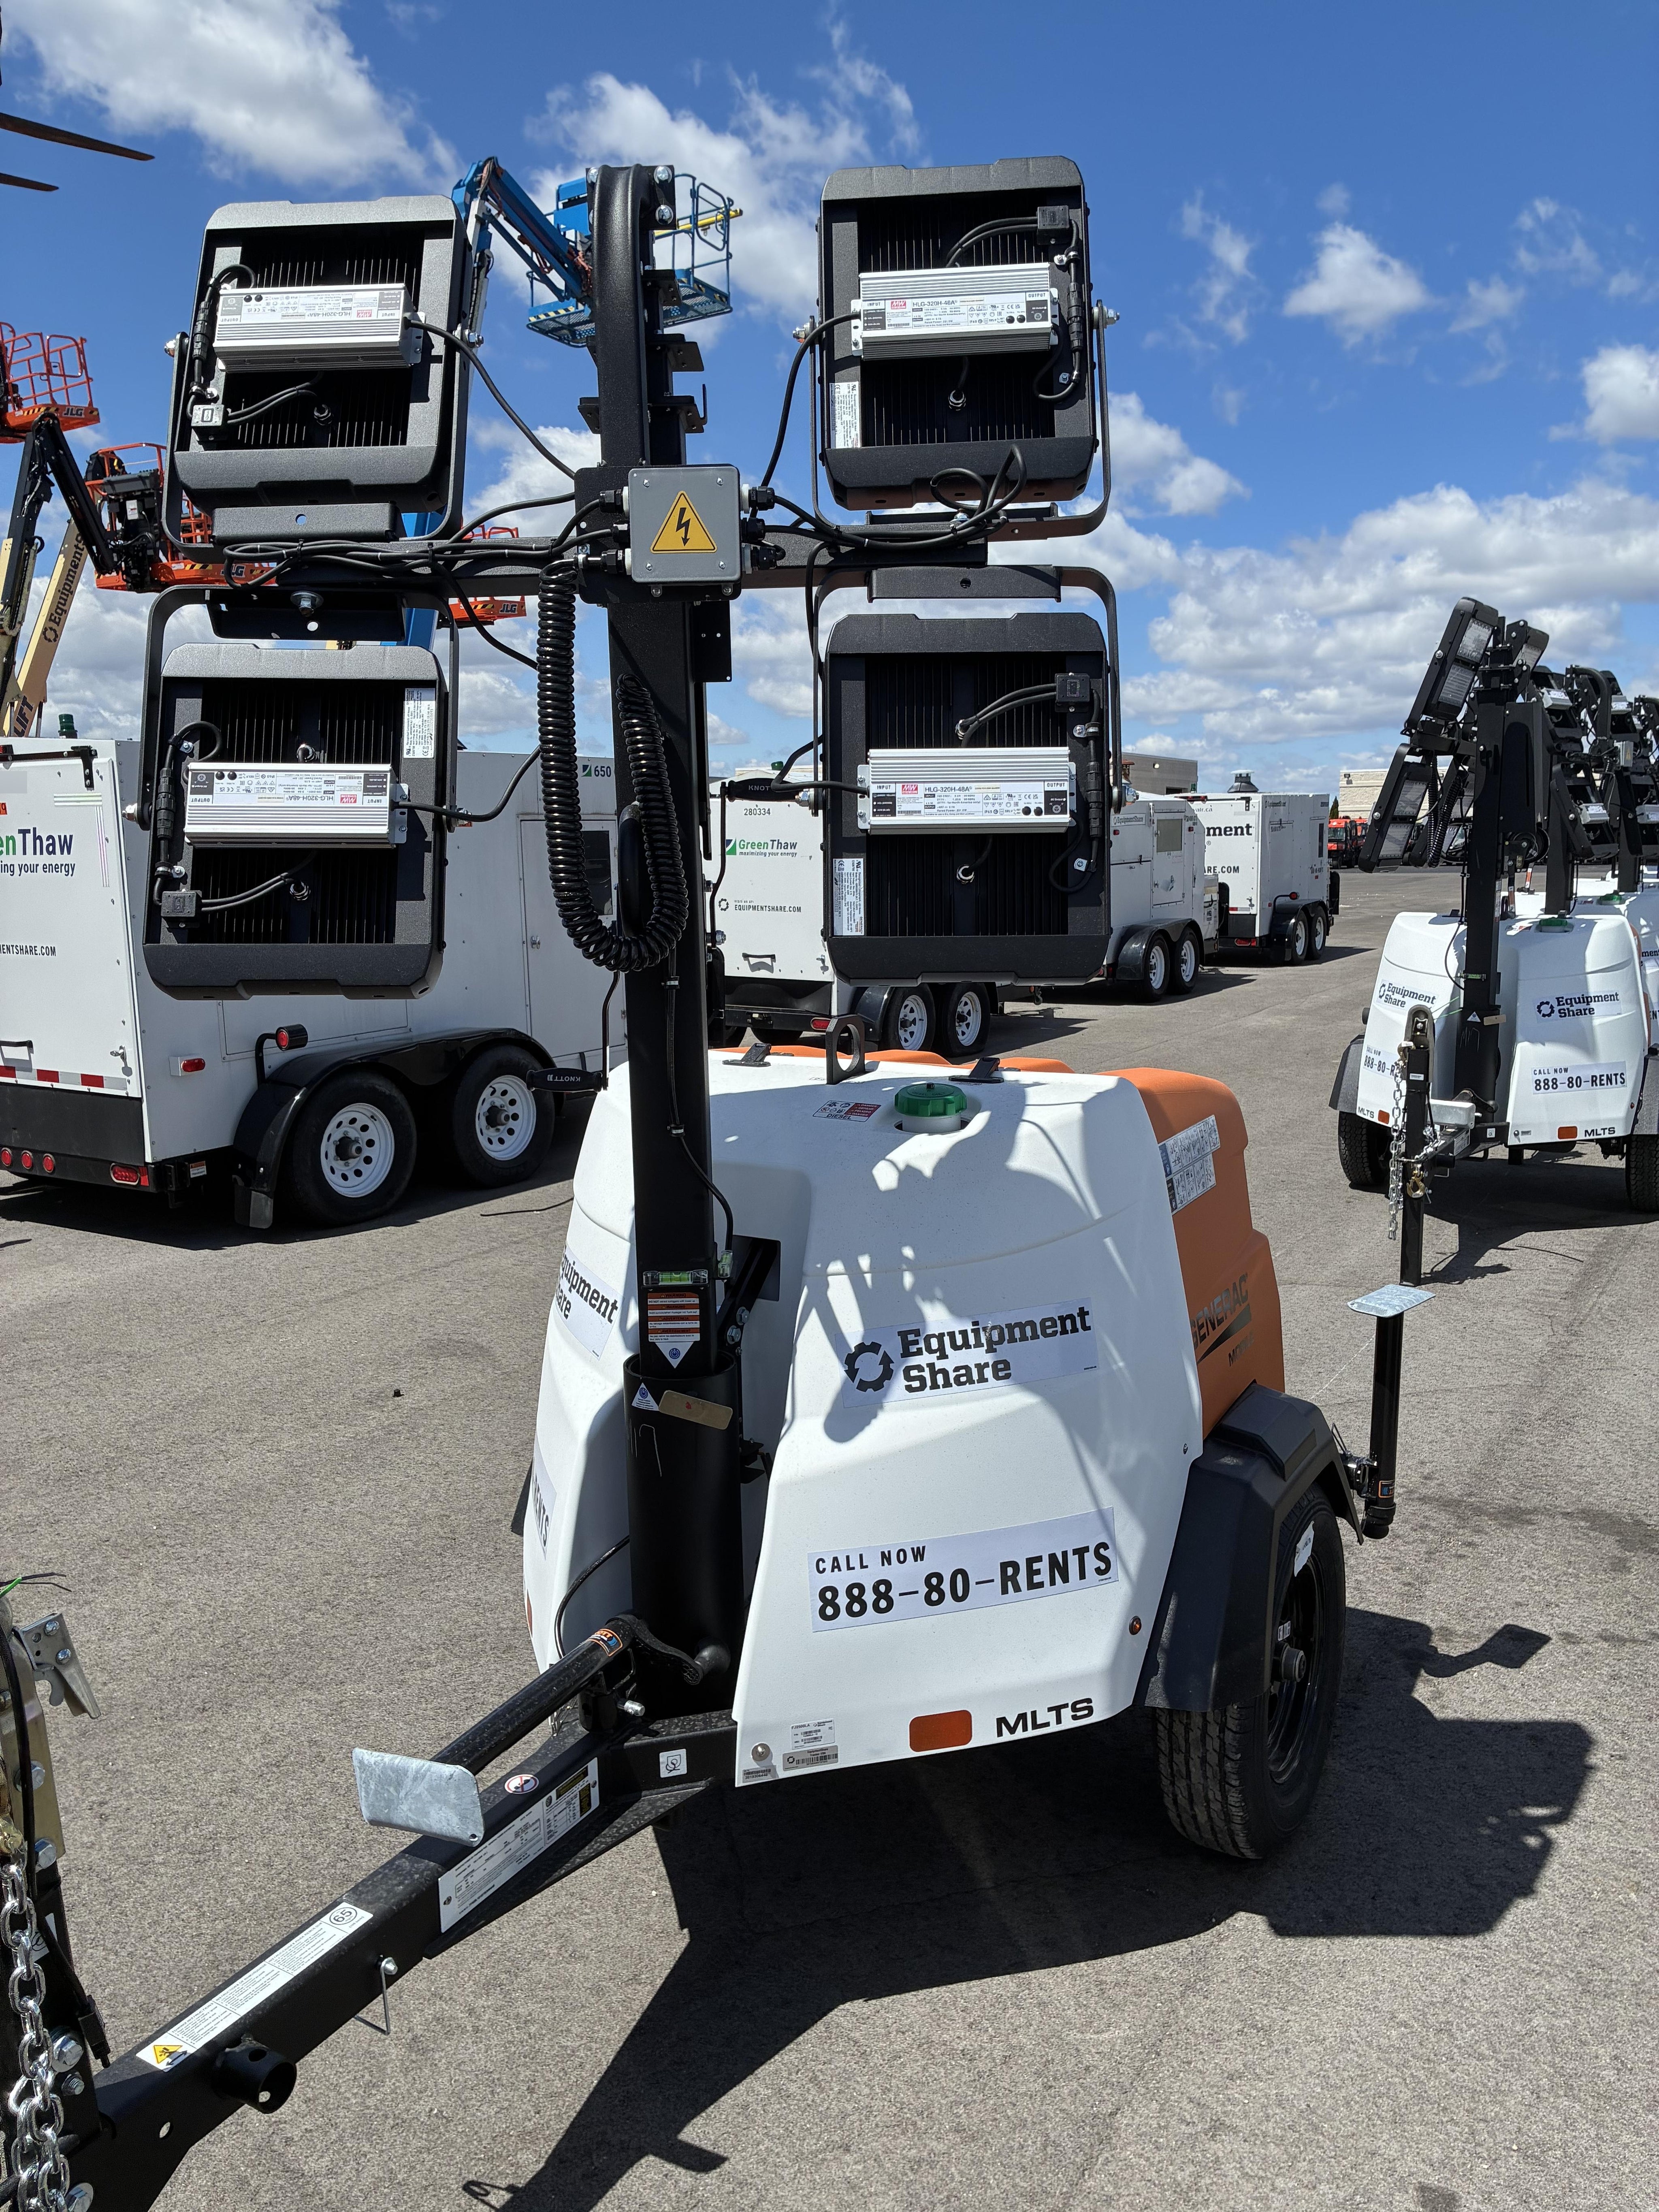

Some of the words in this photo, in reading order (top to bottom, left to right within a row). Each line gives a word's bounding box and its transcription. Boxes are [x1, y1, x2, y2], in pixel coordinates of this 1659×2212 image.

[63, 407, 83, 417] JLG
[499, 602, 517, 614] JLG
[594, 766, 611, 777] 650
[18, 864, 39, 877] your
[42, 864, 76, 877] energy
[735, 904, 802, 913] EQUIPMENTSHARE.COM
[1384, 994, 1406, 1007] Share
[1387, 983, 1436, 1005] Equipment
[1556, 992, 1620, 1007] Equipment
[1558, 1007, 1595, 1018] Share
[1534, 1073, 1625, 1091] 888-80-RENTS
[1358, 1106, 1374, 1118] MLTS
[1584, 1126, 1616, 1138] MLTS
[555, 1282, 571, 1320] hare
[897, 1306, 1092, 1361] Equipment
[902, 1359, 1012, 1393] Share
[815, 1553, 868, 1574] CALL
[880, 1545, 927, 1566] NOW
[817, 1542, 1112, 1621] 888-80-RENTS
[996, 1698, 1094, 1738] MLTS
[334, 1909, 352, 1923] 65
